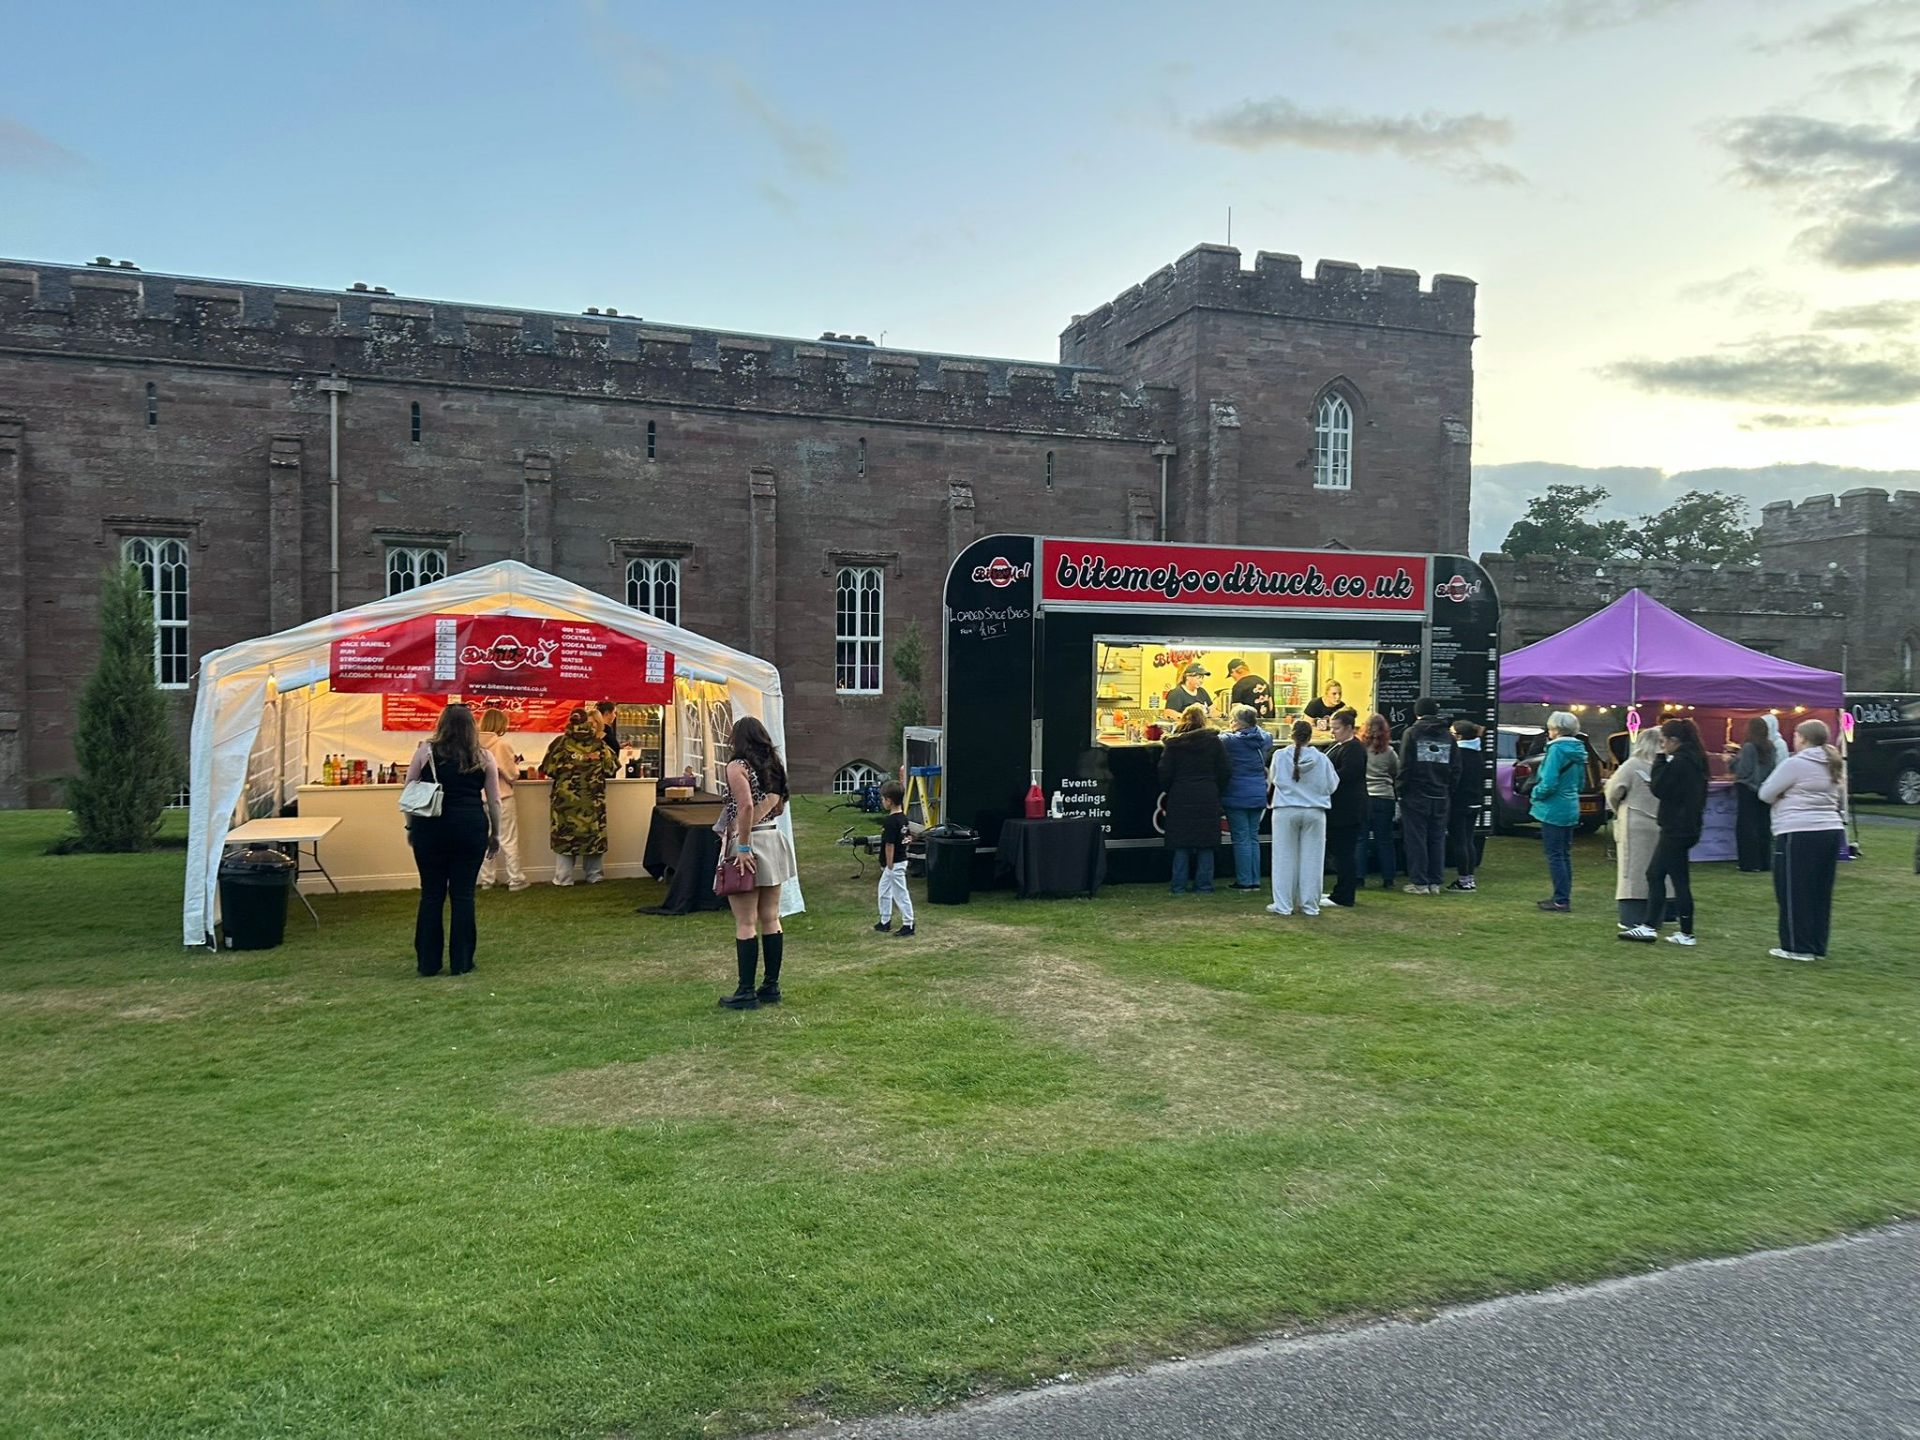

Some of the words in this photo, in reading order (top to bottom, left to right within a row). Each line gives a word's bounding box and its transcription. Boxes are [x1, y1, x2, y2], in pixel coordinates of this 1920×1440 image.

[1055, 554, 1414, 599] bitemefoodtruck.co.uk
[949, 608, 985, 622] LOADED
[1006, 606, 1031, 619] BAGS
[561, 634, 596, 642] COCKTAILS
[1061, 779, 1098, 788] Events
[1088, 808, 1111, 817] Hire
